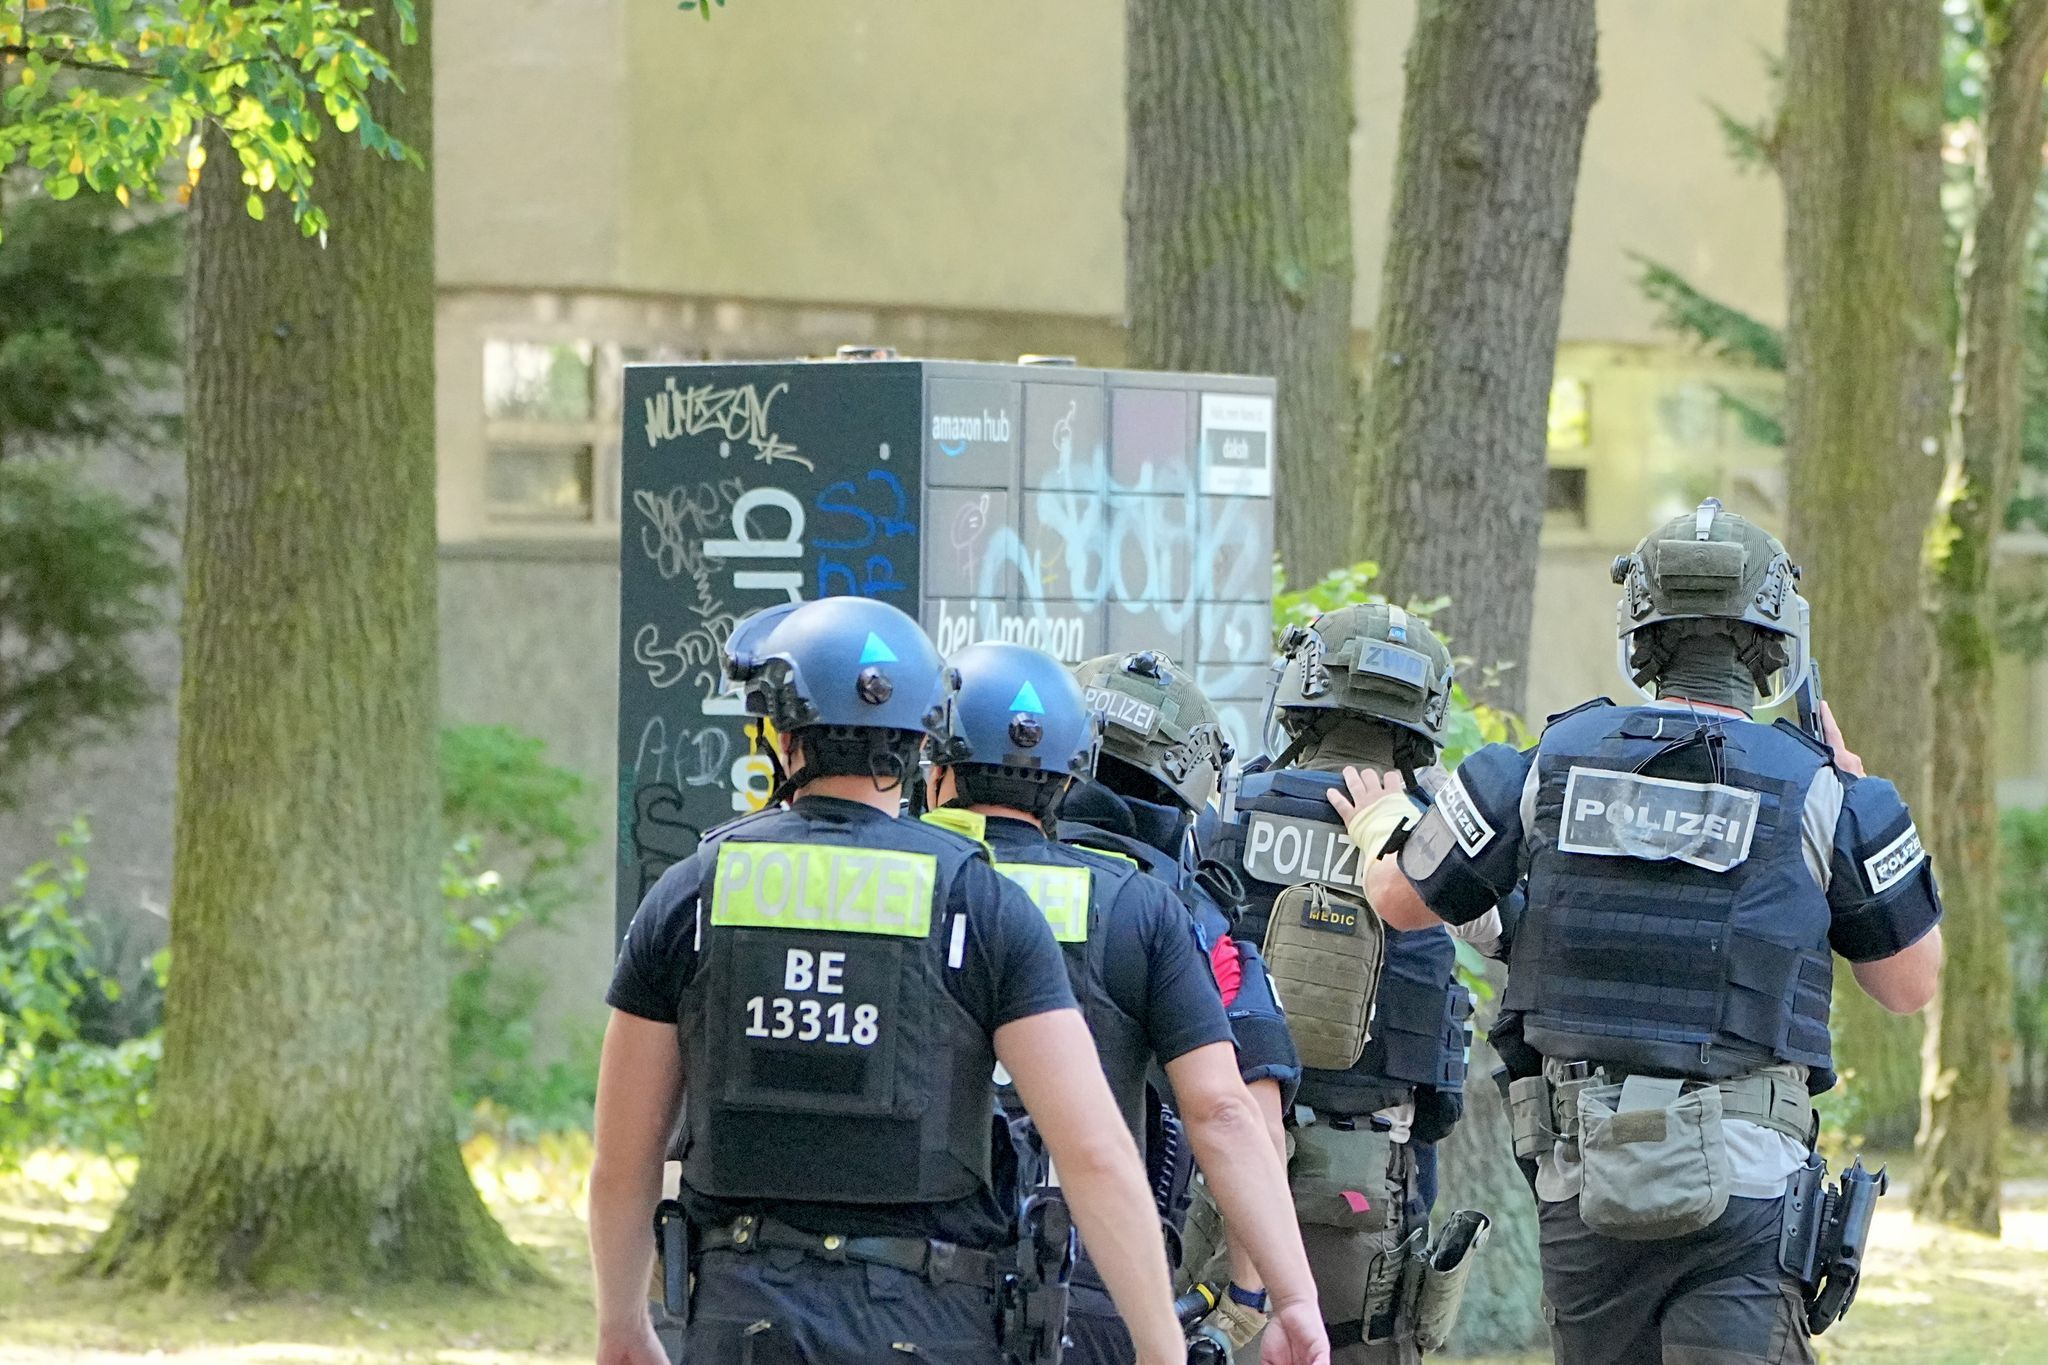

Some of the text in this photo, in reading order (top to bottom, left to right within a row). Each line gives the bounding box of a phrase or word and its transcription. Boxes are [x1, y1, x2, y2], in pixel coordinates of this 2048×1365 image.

[932, 408, 1009, 442] amazon hub
[937, 598, 976, 660] bei
[1085, 688, 1154, 730] POLIZEI
[1575, 798, 1741, 844] POLIZEI
[718, 851, 925, 928] POLIZEI
[784, 948, 847, 994] BE
[745, 996, 879, 1046] 13318
